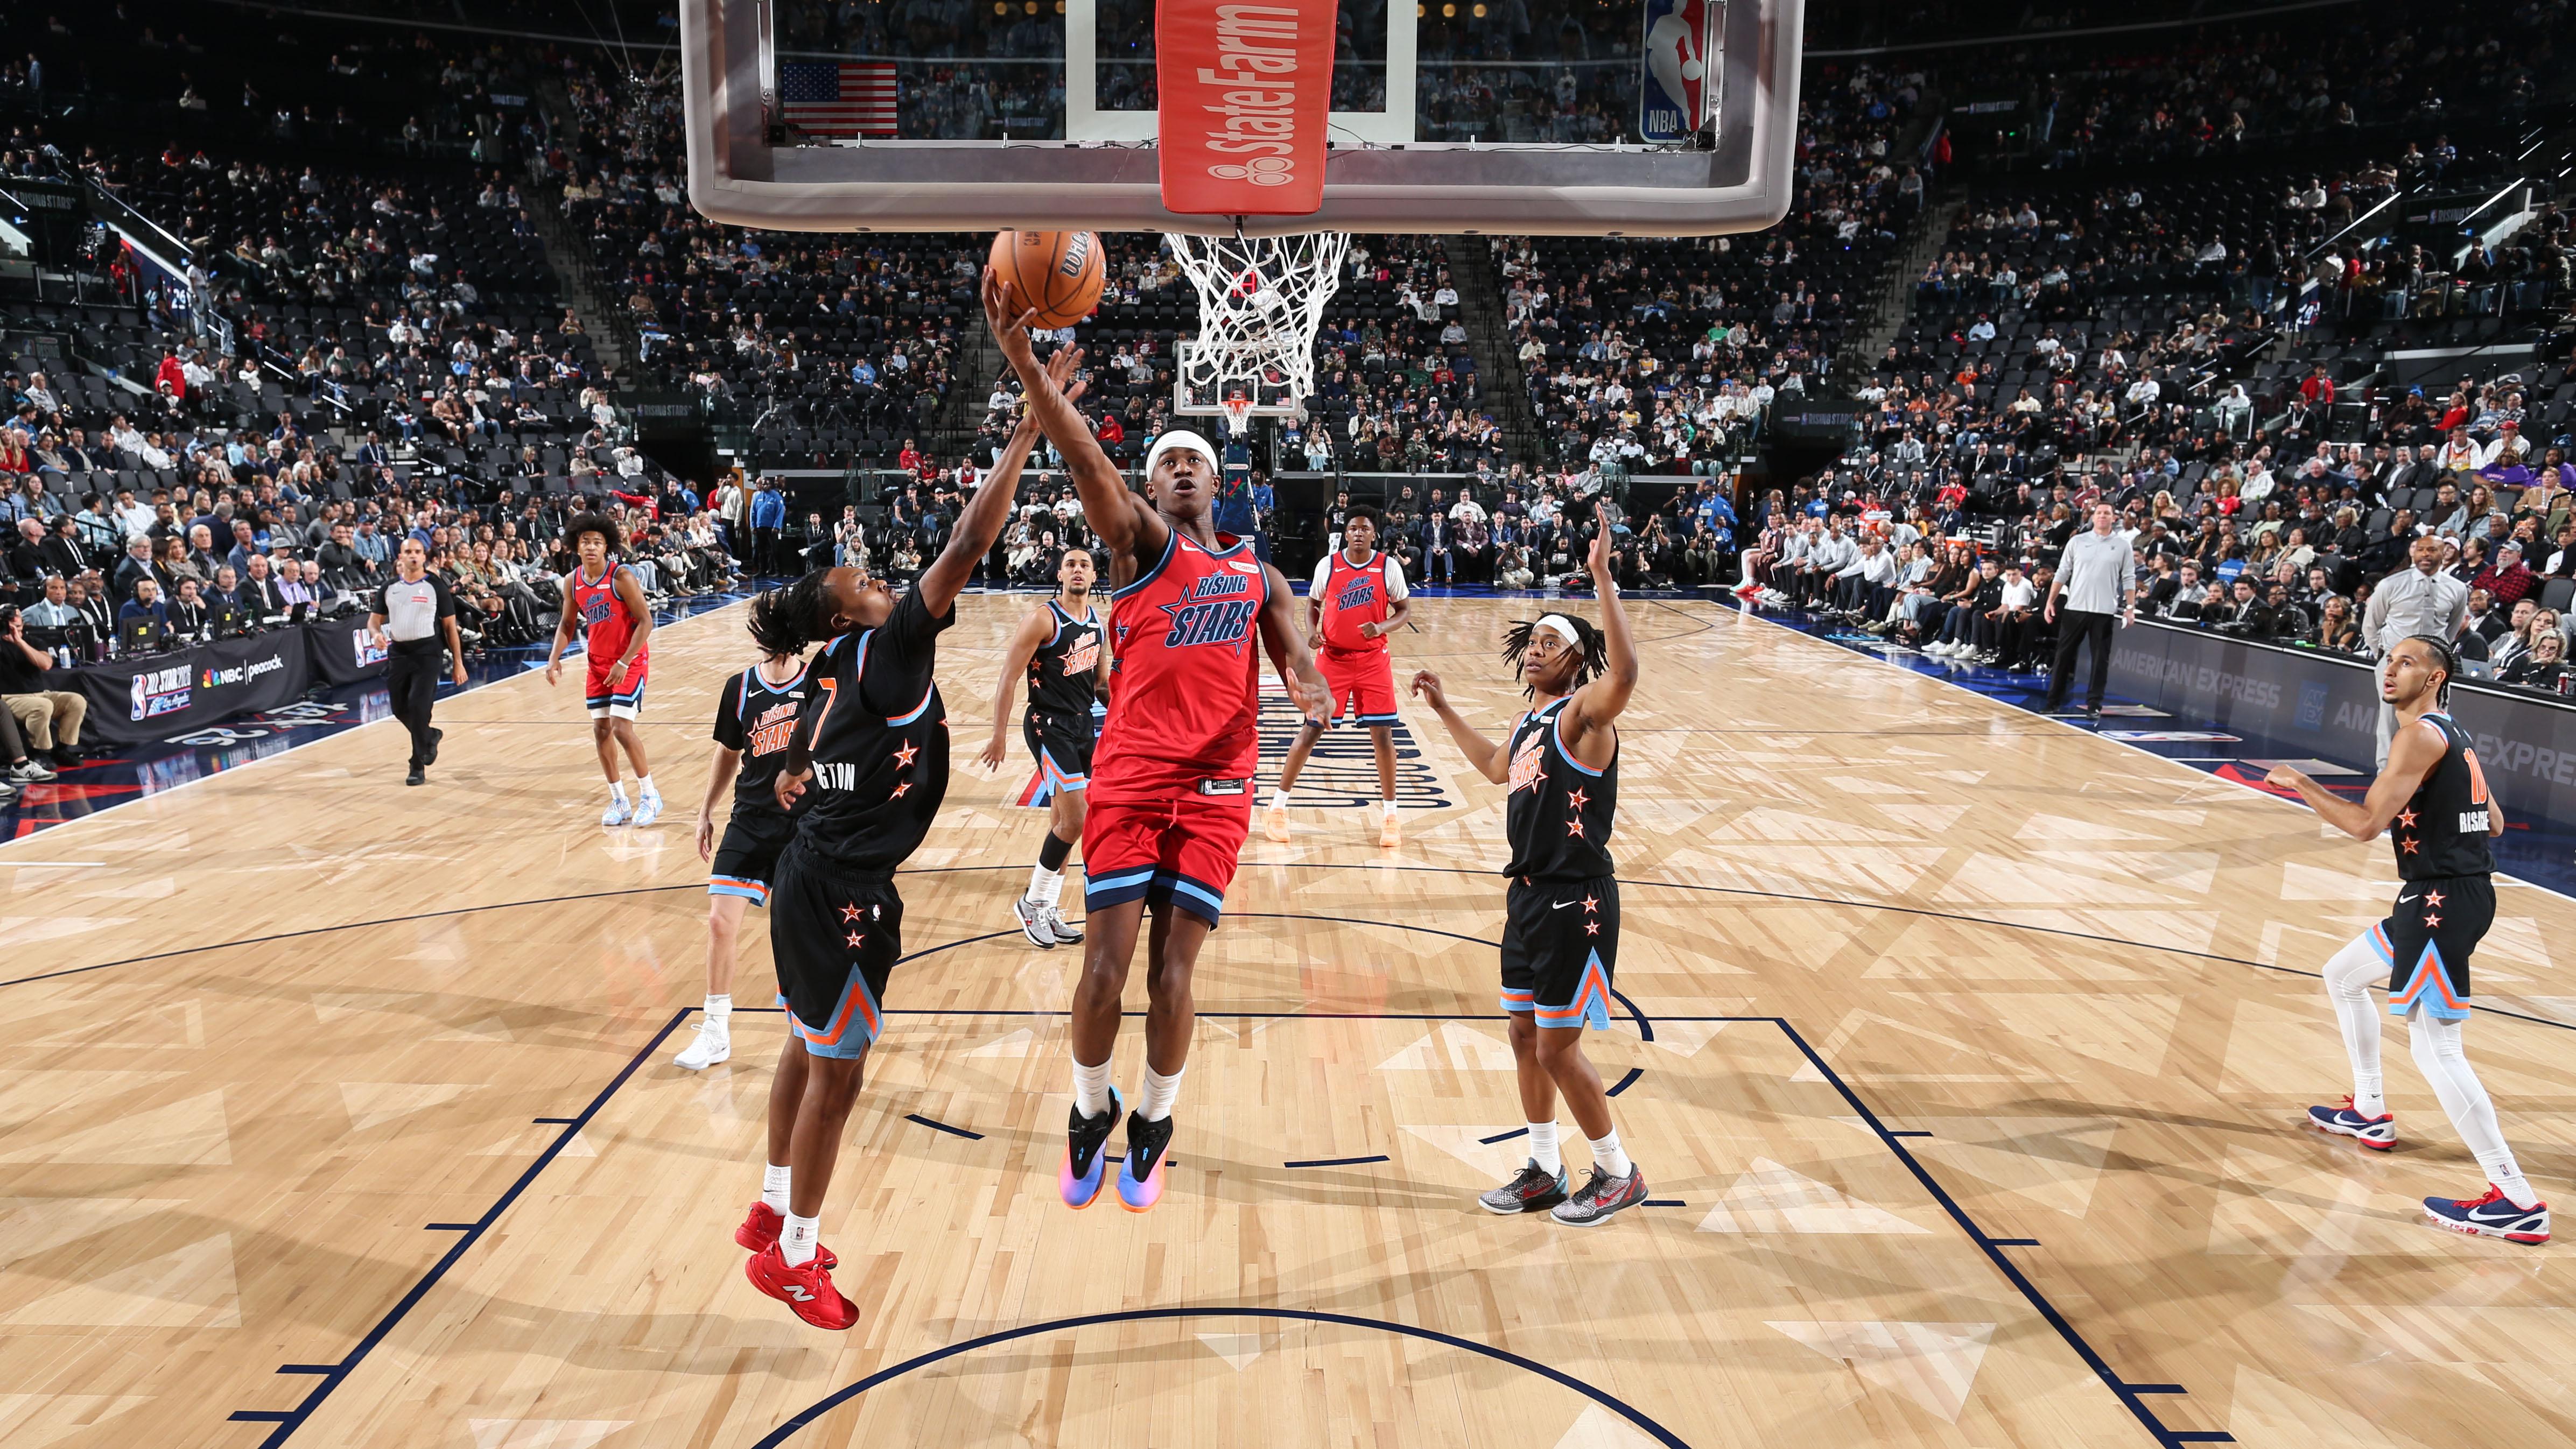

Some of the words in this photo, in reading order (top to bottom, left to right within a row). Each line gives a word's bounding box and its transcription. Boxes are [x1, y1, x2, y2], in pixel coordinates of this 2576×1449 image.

[1649, 110, 1677, 133] NBA
[1193, 574, 1248, 599] RISING
[1346, 575, 1371, 590] RISING
[586, 593, 604, 606] RISING
[1338, 585, 1375, 611] STARS
[1164, 599, 1257, 648] STARS
[1073, 631, 1096, 651] RISING
[220, 667, 243, 684] NBC
[248, 653, 283, 683] peacock
[1063, 644, 1100, 677] STARS
[145, 672, 159, 695] ALL
[2111, 648, 2194, 686] AMERICAN
[2195, 667, 2282, 709] EXPRESS
[760, 701, 798, 726] RISING
[808, 677, 838, 752] 7
